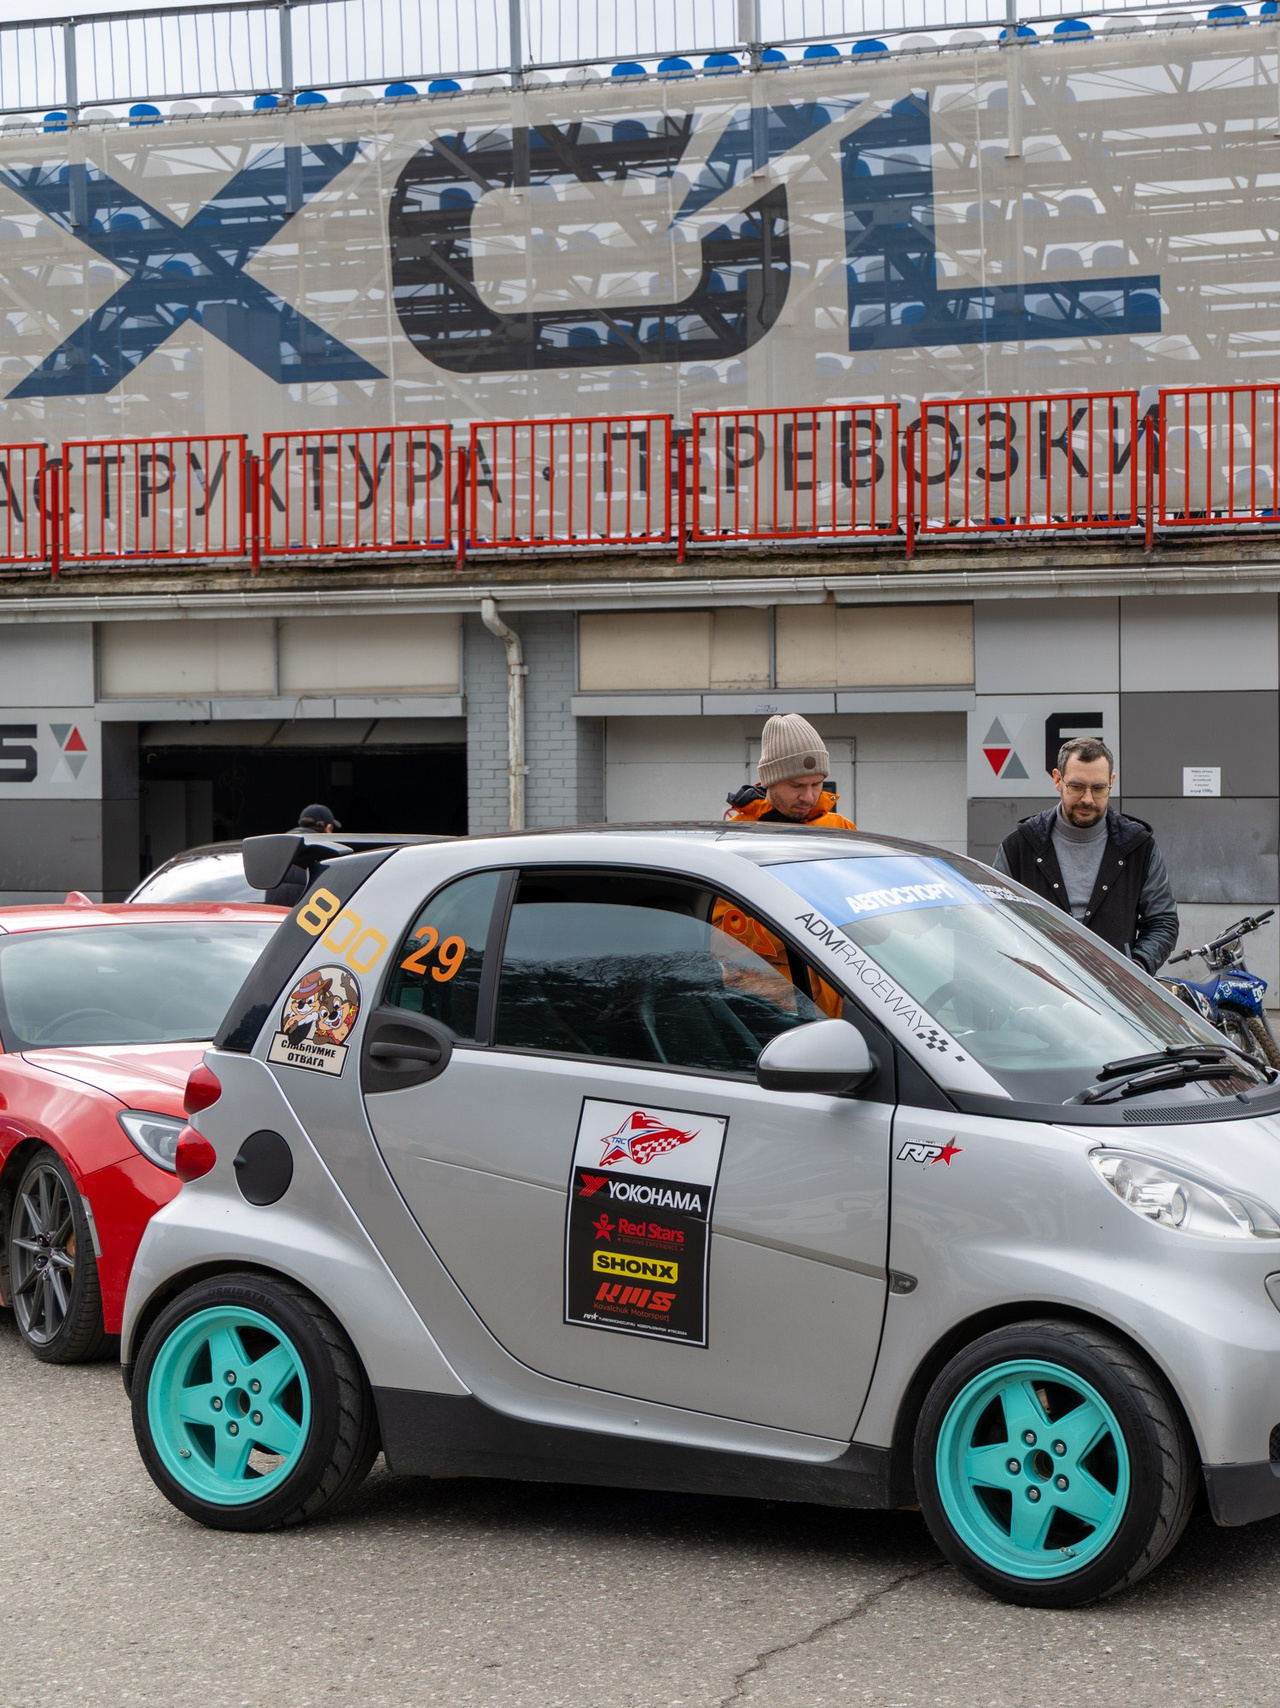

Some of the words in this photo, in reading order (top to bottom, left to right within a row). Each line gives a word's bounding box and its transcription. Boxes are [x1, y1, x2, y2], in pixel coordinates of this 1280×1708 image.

[602, 404, 1161, 495] ПЕРЕВОЗКИ
[845, 883, 955, 914] АВТОСПОРТ
[296, 887, 389, 974] 800
[401, 926, 467, 983] 29
[287, 1052, 324, 1067] ОТВАГА
[611, 1136, 627, 1145] TRC
[608, 1180, 702, 1212] YOKOHAMA
[618, 1218, 646, 1237] Red
[648, 1223, 685, 1243] Stars
[596, 1255, 674, 1279] SHONX
[593, 1302, 629, 1315] Kovalchuk
[630, 1307, 670, 1321] Motorsport
